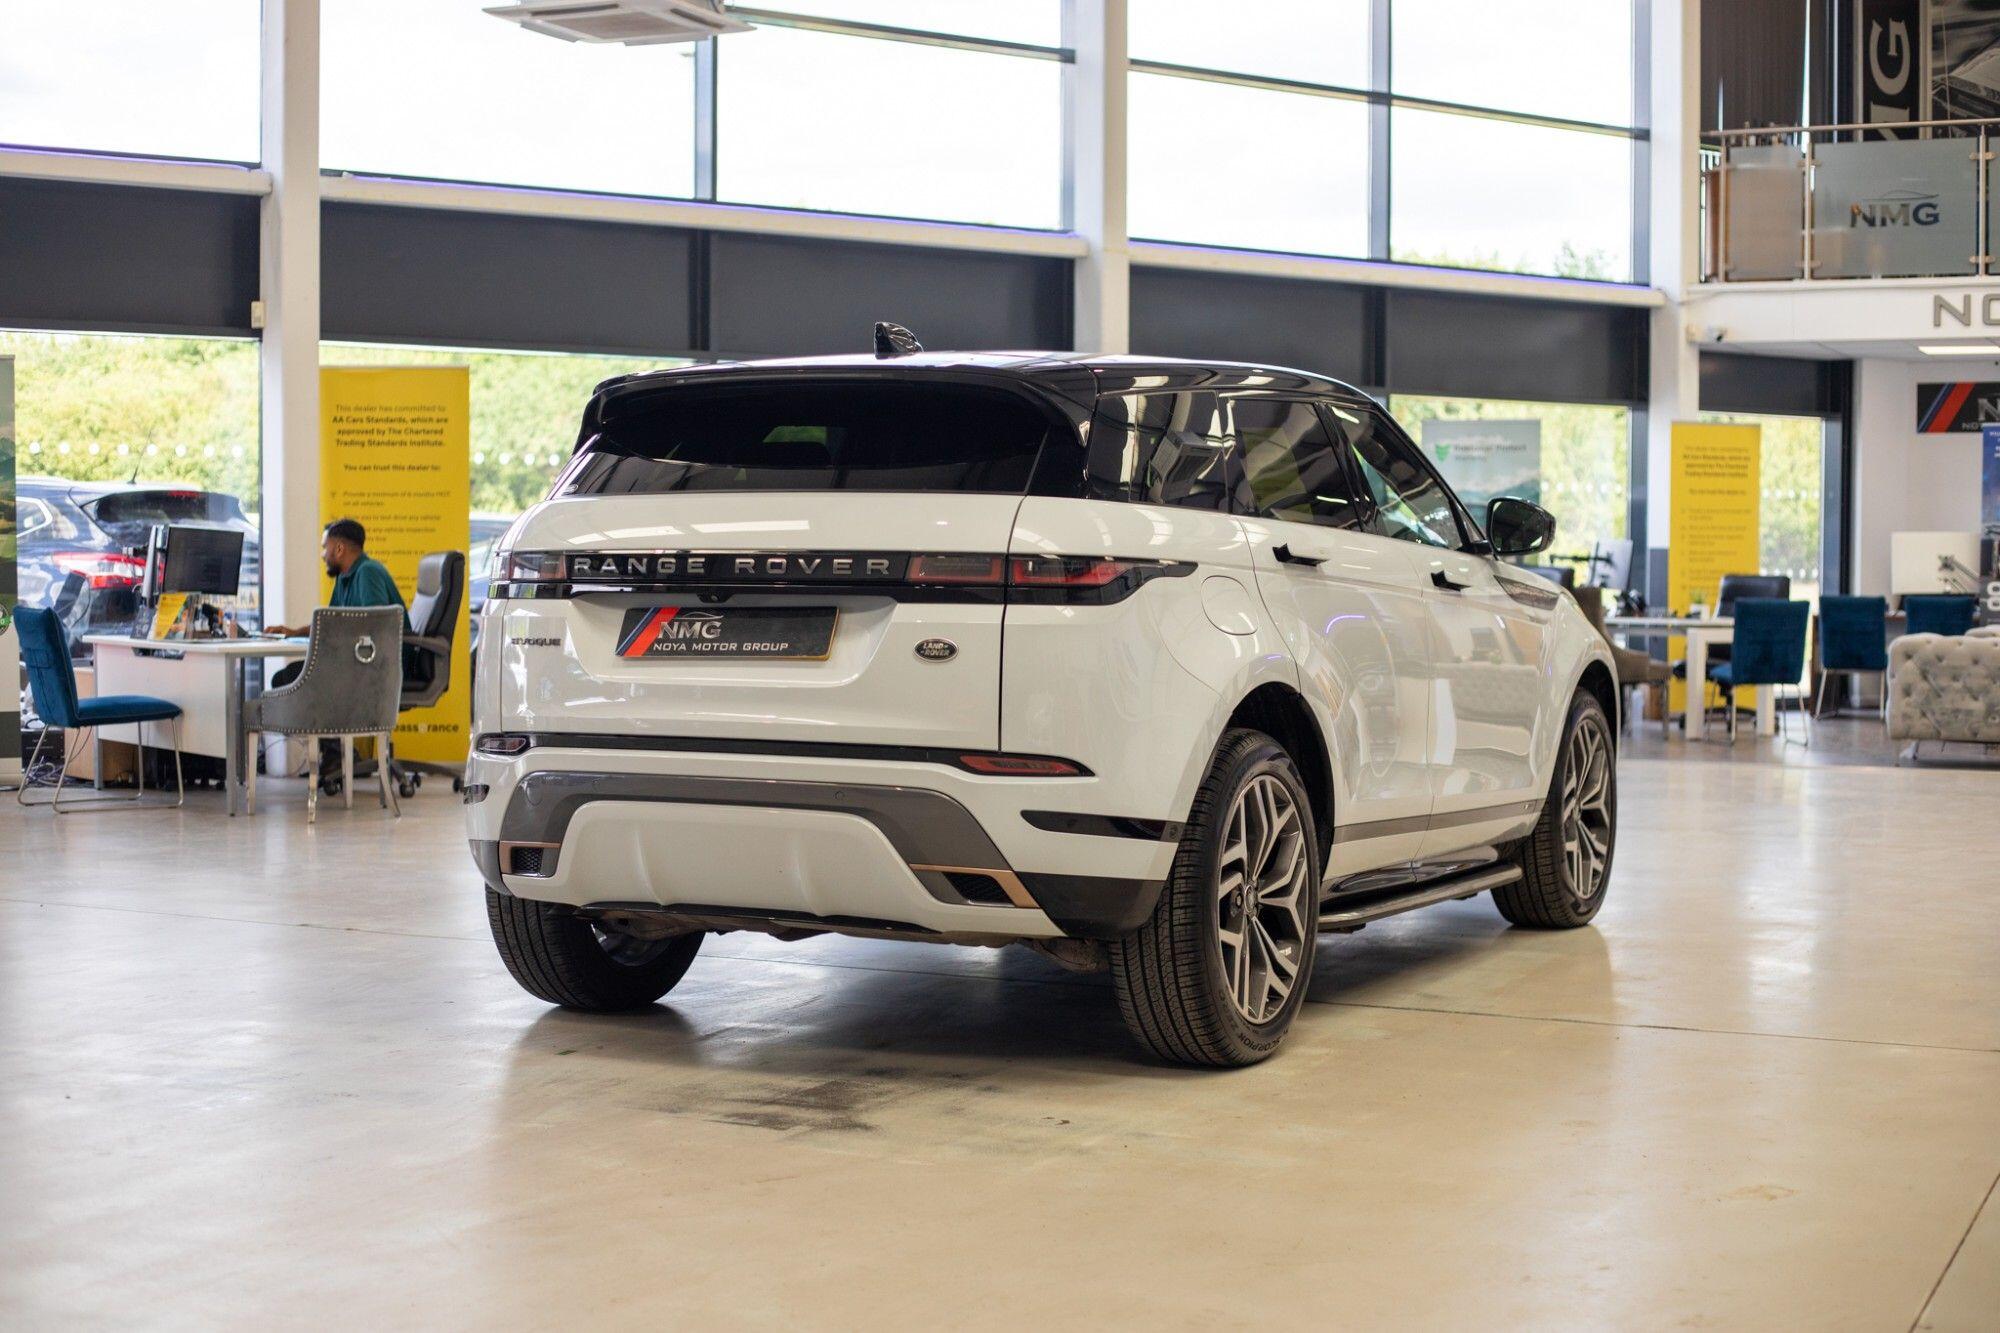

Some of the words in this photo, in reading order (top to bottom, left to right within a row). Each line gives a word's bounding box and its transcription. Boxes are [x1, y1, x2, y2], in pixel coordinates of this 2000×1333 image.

[1850, 203, 1940, 227] NMG
[573, 556, 706, 575] RANGE
[734, 557, 890, 576] ROVER
[658, 620, 722, 639] NMG
[652, 642, 687, 651] NOYA
[691, 642, 738, 651] MOTOR
[742, 642, 789, 651] GROUP
